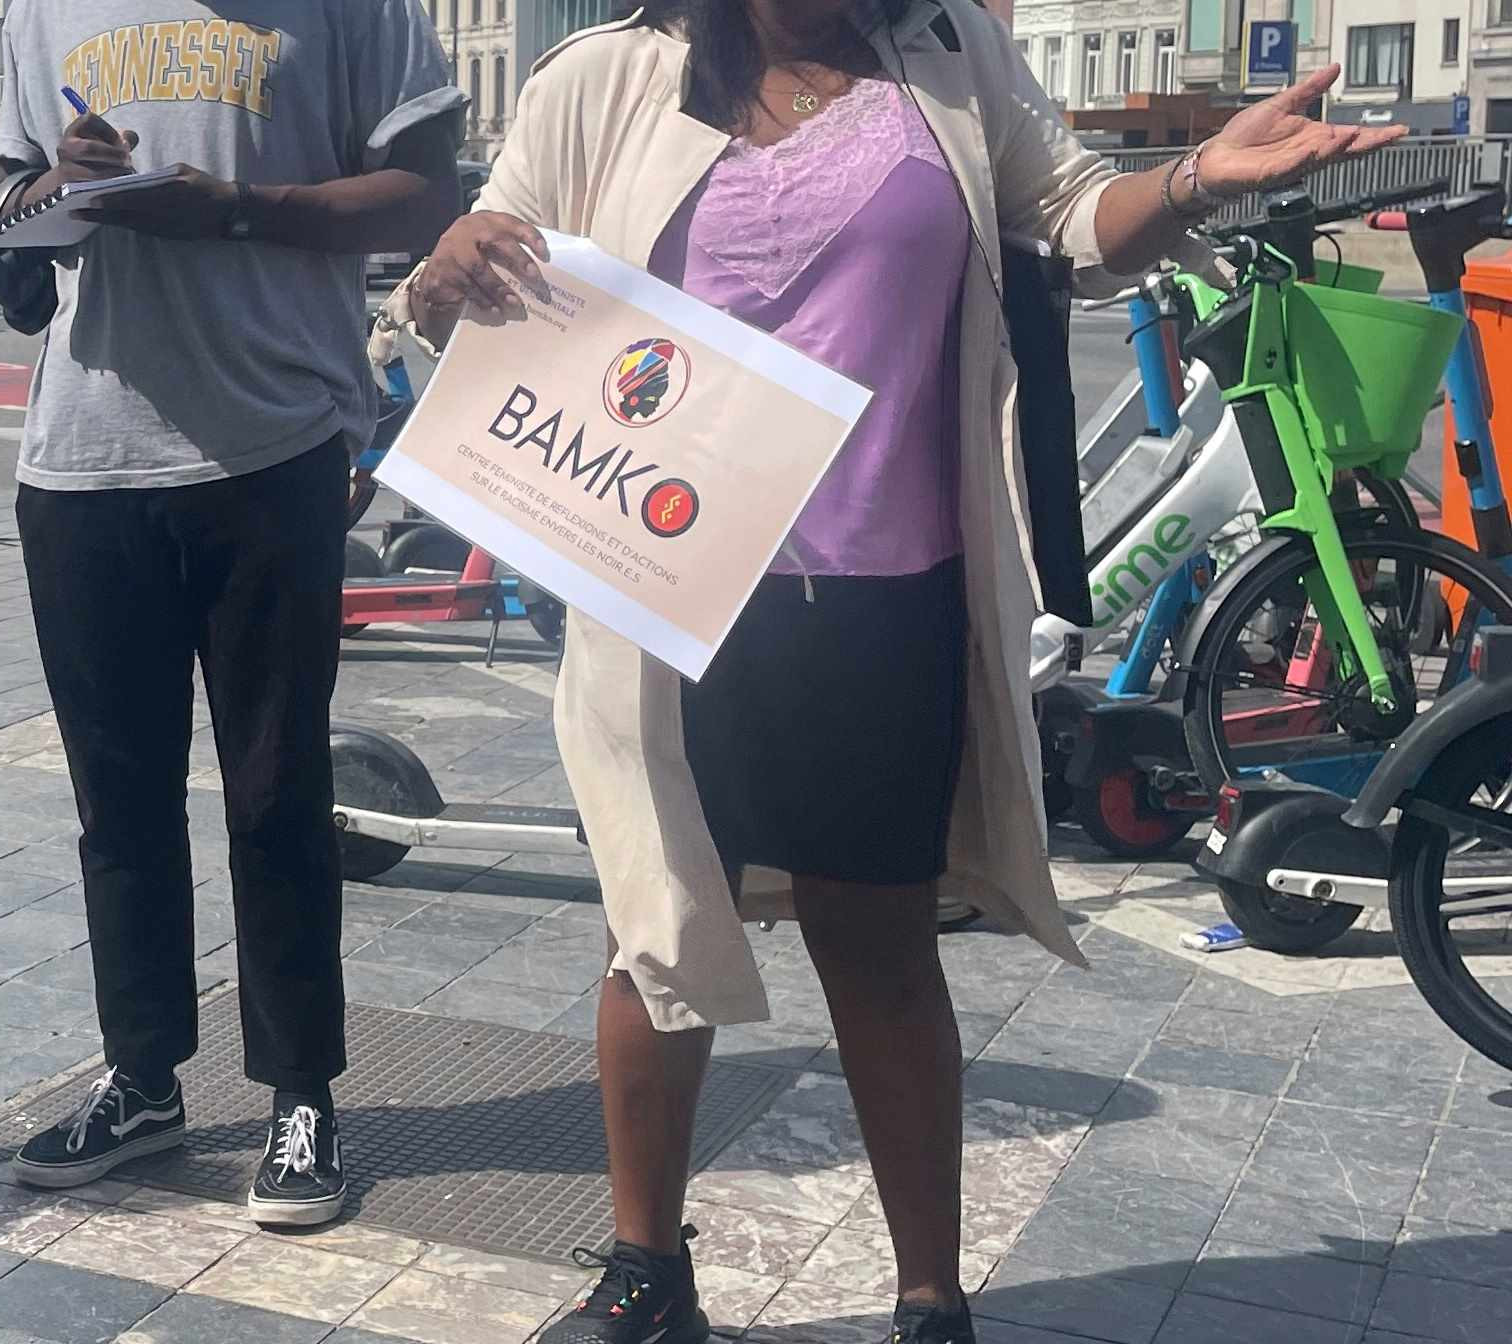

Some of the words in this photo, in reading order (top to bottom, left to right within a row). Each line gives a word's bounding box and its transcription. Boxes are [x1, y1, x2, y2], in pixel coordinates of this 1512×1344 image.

[1261, 26, 1281, 58] P
[1456, 100, 1468, 118] P
[456, 443, 491, 470] CENTRE
[535, 492, 551, 506] DE
[607, 536, 622, 550] ET
[488, 384, 700, 538] BAMKO
[470, 471, 490, 489] SUR
[488, 482, 502, 496] LE
[500, 490, 541, 521] RACISME
[540, 515, 577, 544] ENVERS
[576, 538, 598, 556] LES
